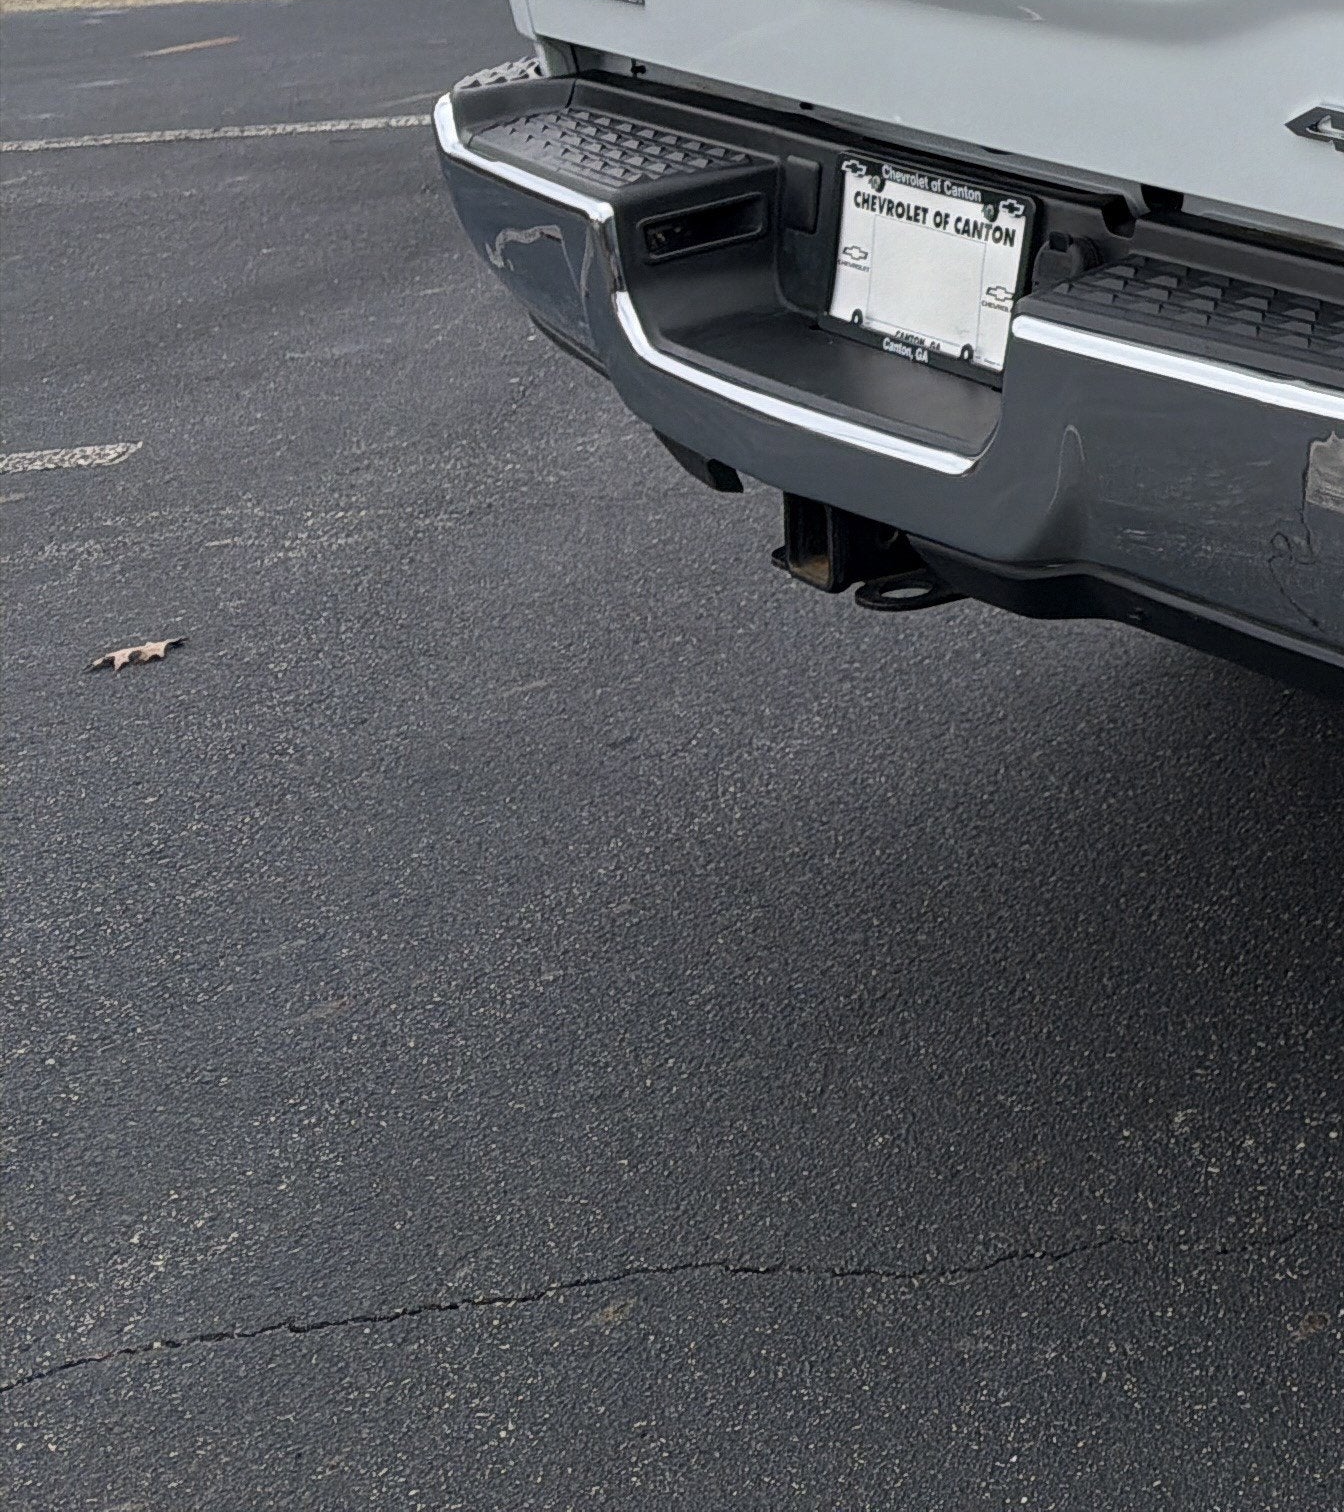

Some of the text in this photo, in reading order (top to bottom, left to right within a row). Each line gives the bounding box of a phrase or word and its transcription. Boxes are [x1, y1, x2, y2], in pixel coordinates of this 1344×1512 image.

[881, 164, 982, 202] Chevrolet of Canton
[853, 190, 1017, 248] CHEVROLET OF CANTON
[914, 347, 929, 364] GA
